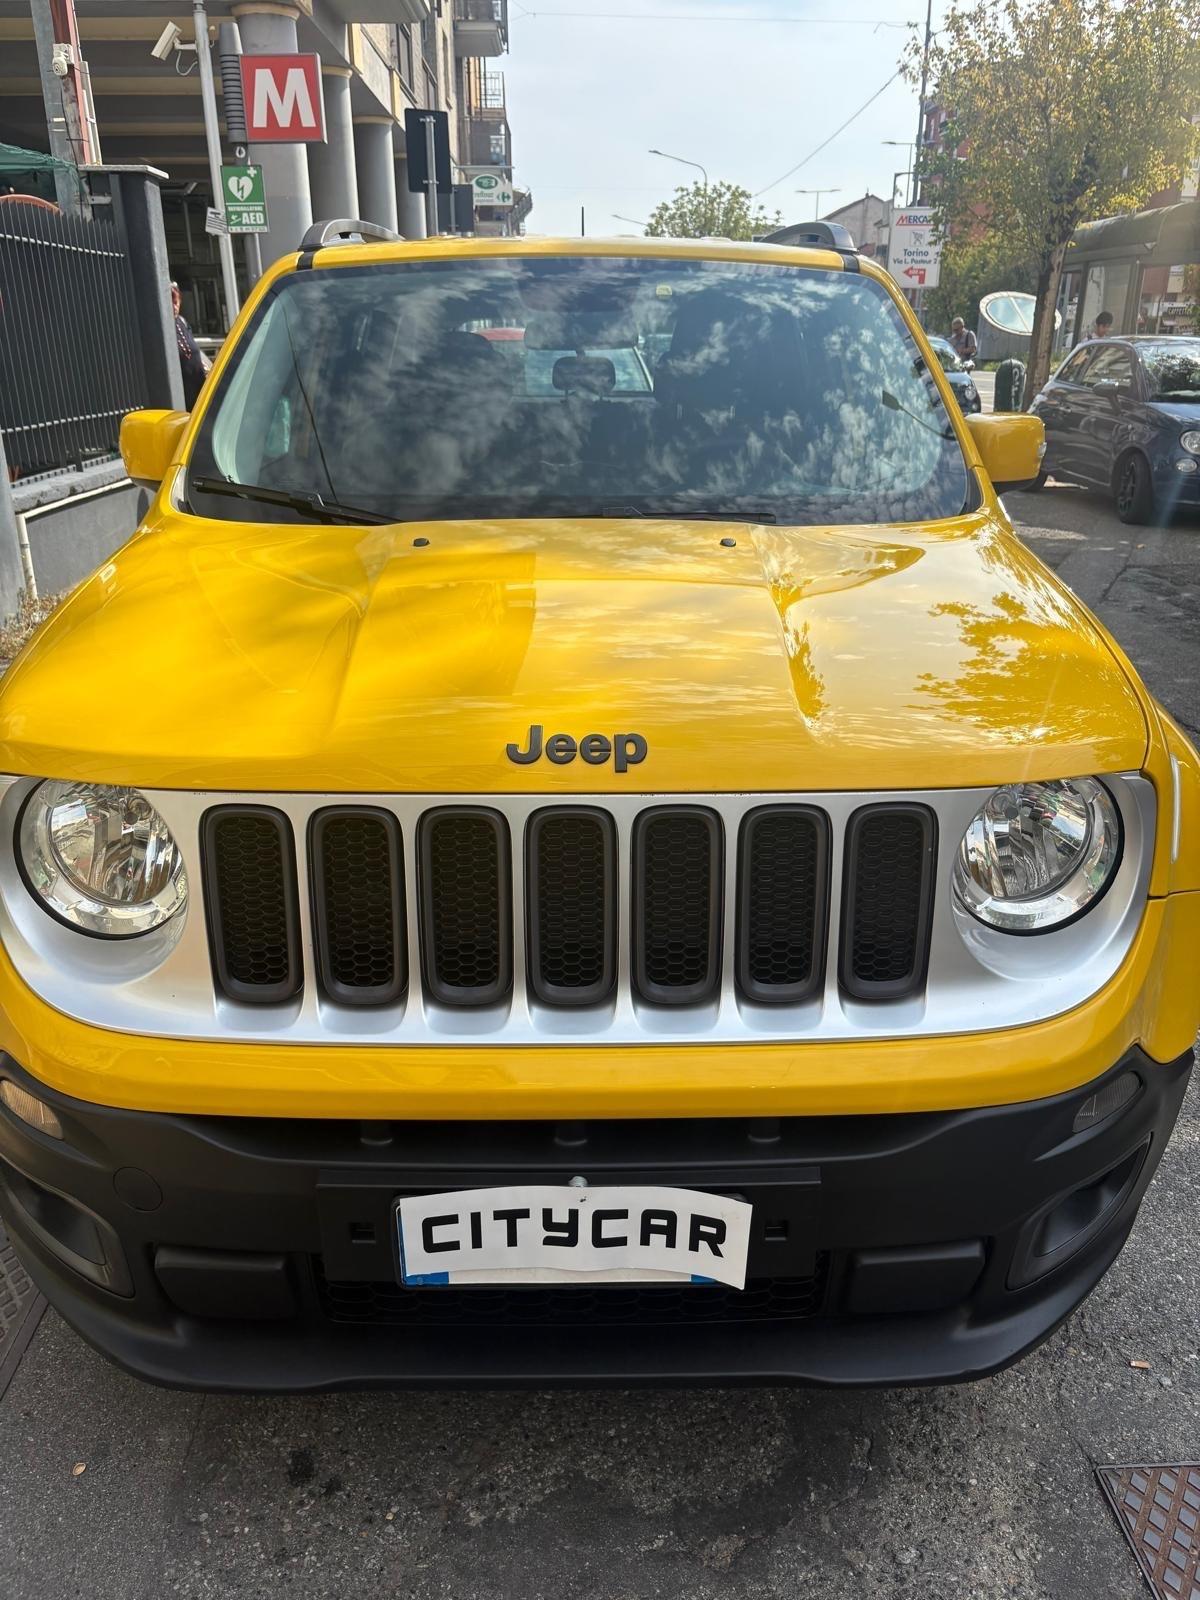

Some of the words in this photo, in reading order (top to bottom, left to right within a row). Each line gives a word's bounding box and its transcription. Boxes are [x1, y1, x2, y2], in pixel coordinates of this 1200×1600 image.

[253, 68, 316, 128] M
[242, 212, 264, 225] AED
[896, 215, 930, 225] MERCA
[903, 248, 929, 257] Torino
[506, 725, 647, 773] Jeep
[421, 1207, 728, 1259] CITYCAR
